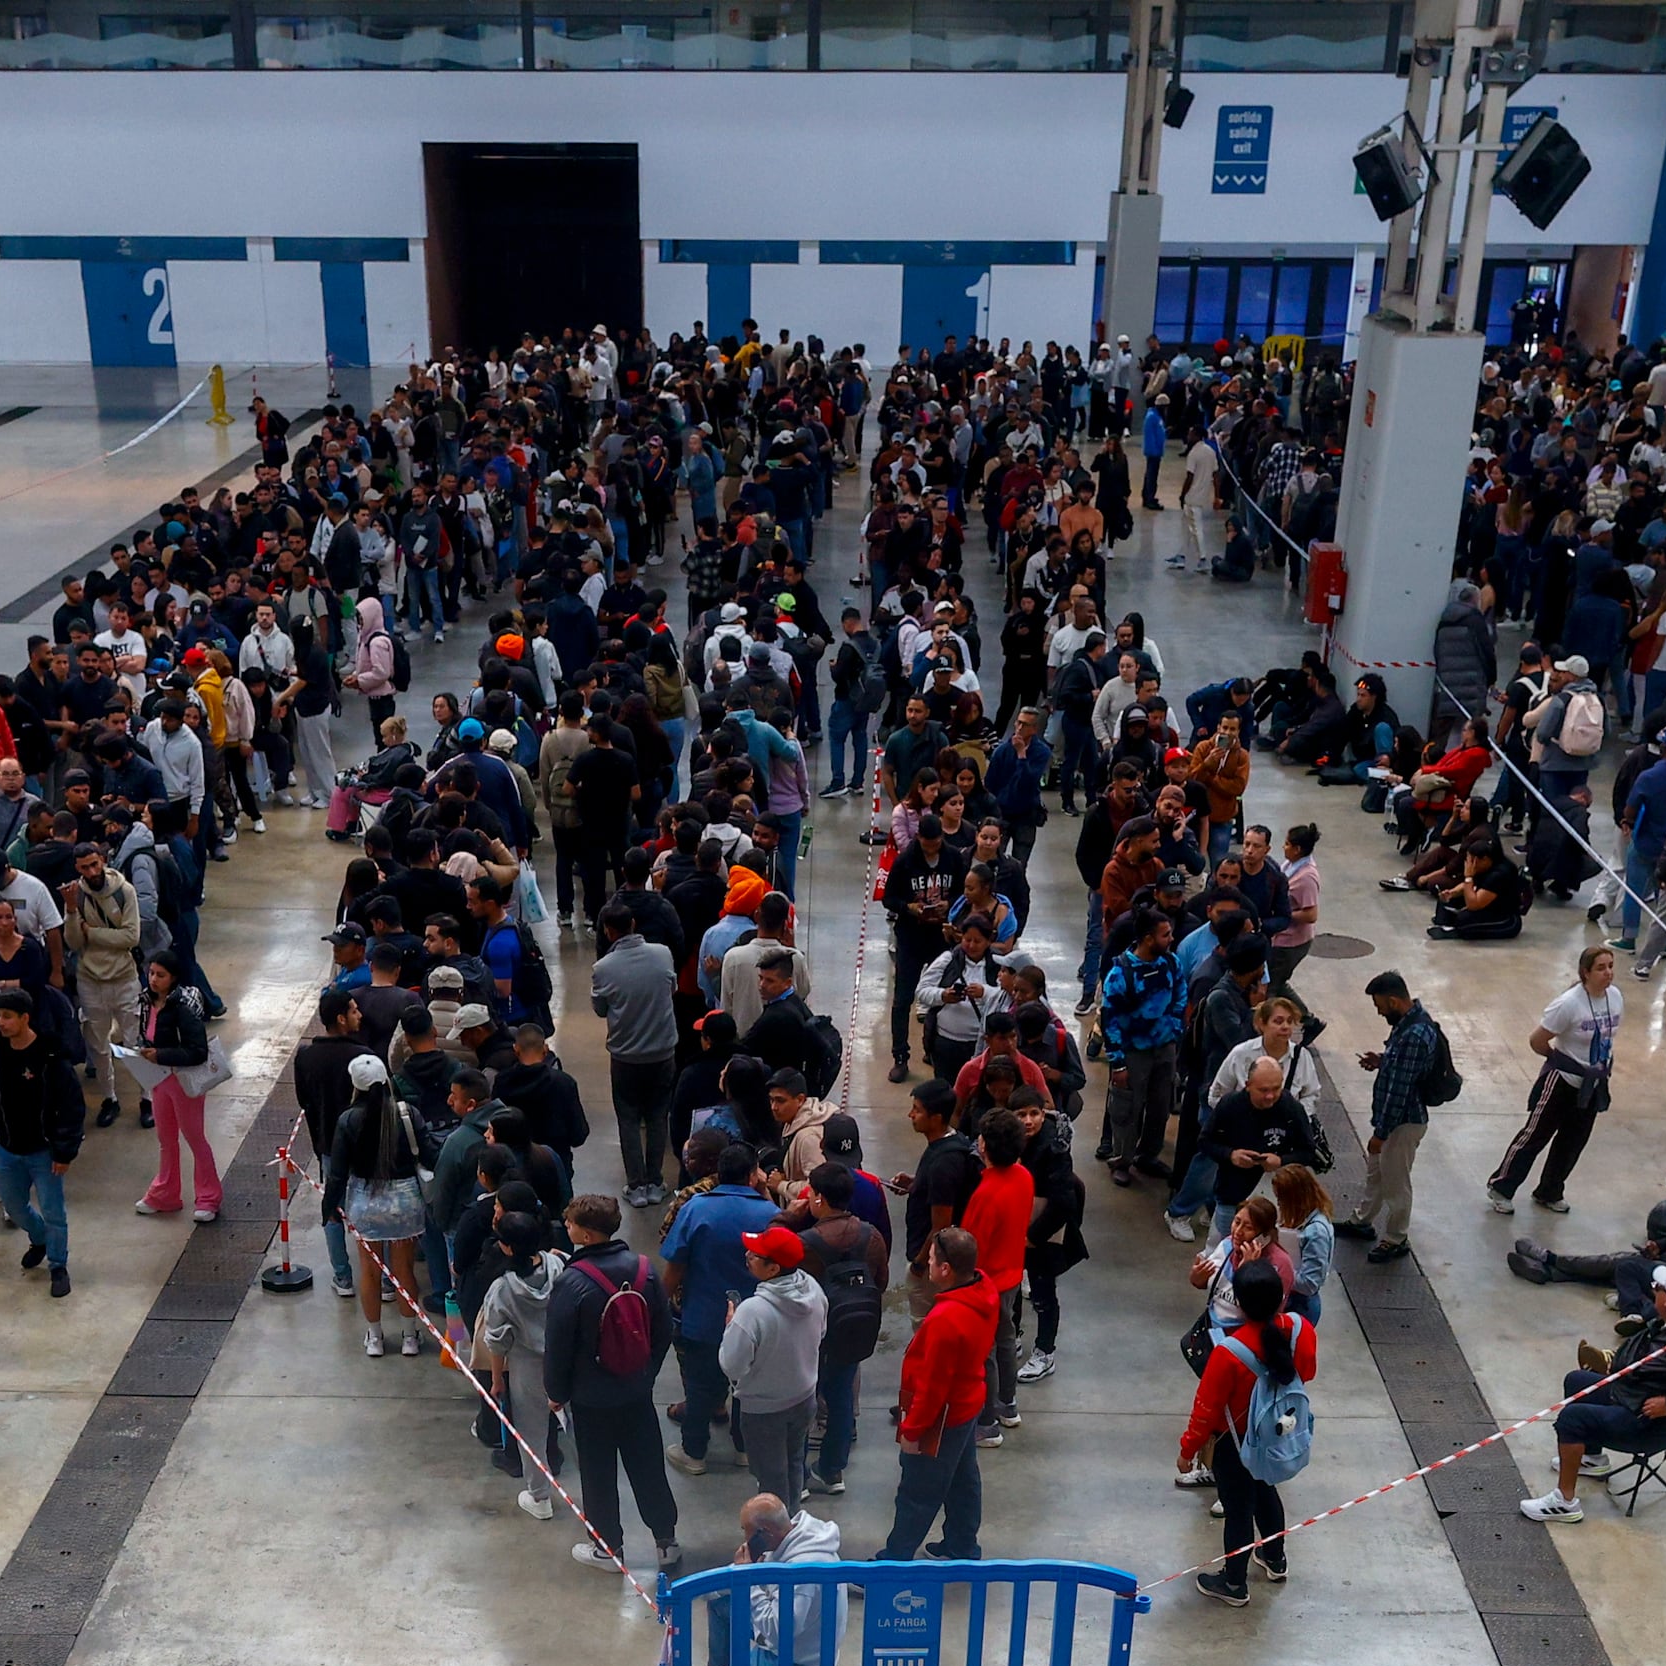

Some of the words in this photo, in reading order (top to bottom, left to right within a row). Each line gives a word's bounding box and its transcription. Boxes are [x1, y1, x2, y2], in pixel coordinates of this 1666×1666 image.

[1233, 142, 1252, 154] exit
[142, 267, 173, 344] 2
[1168, 872, 1181, 884] ek
[878, 1618, 891, 1628] LA
[894, 1617, 927, 1627] FARGA
